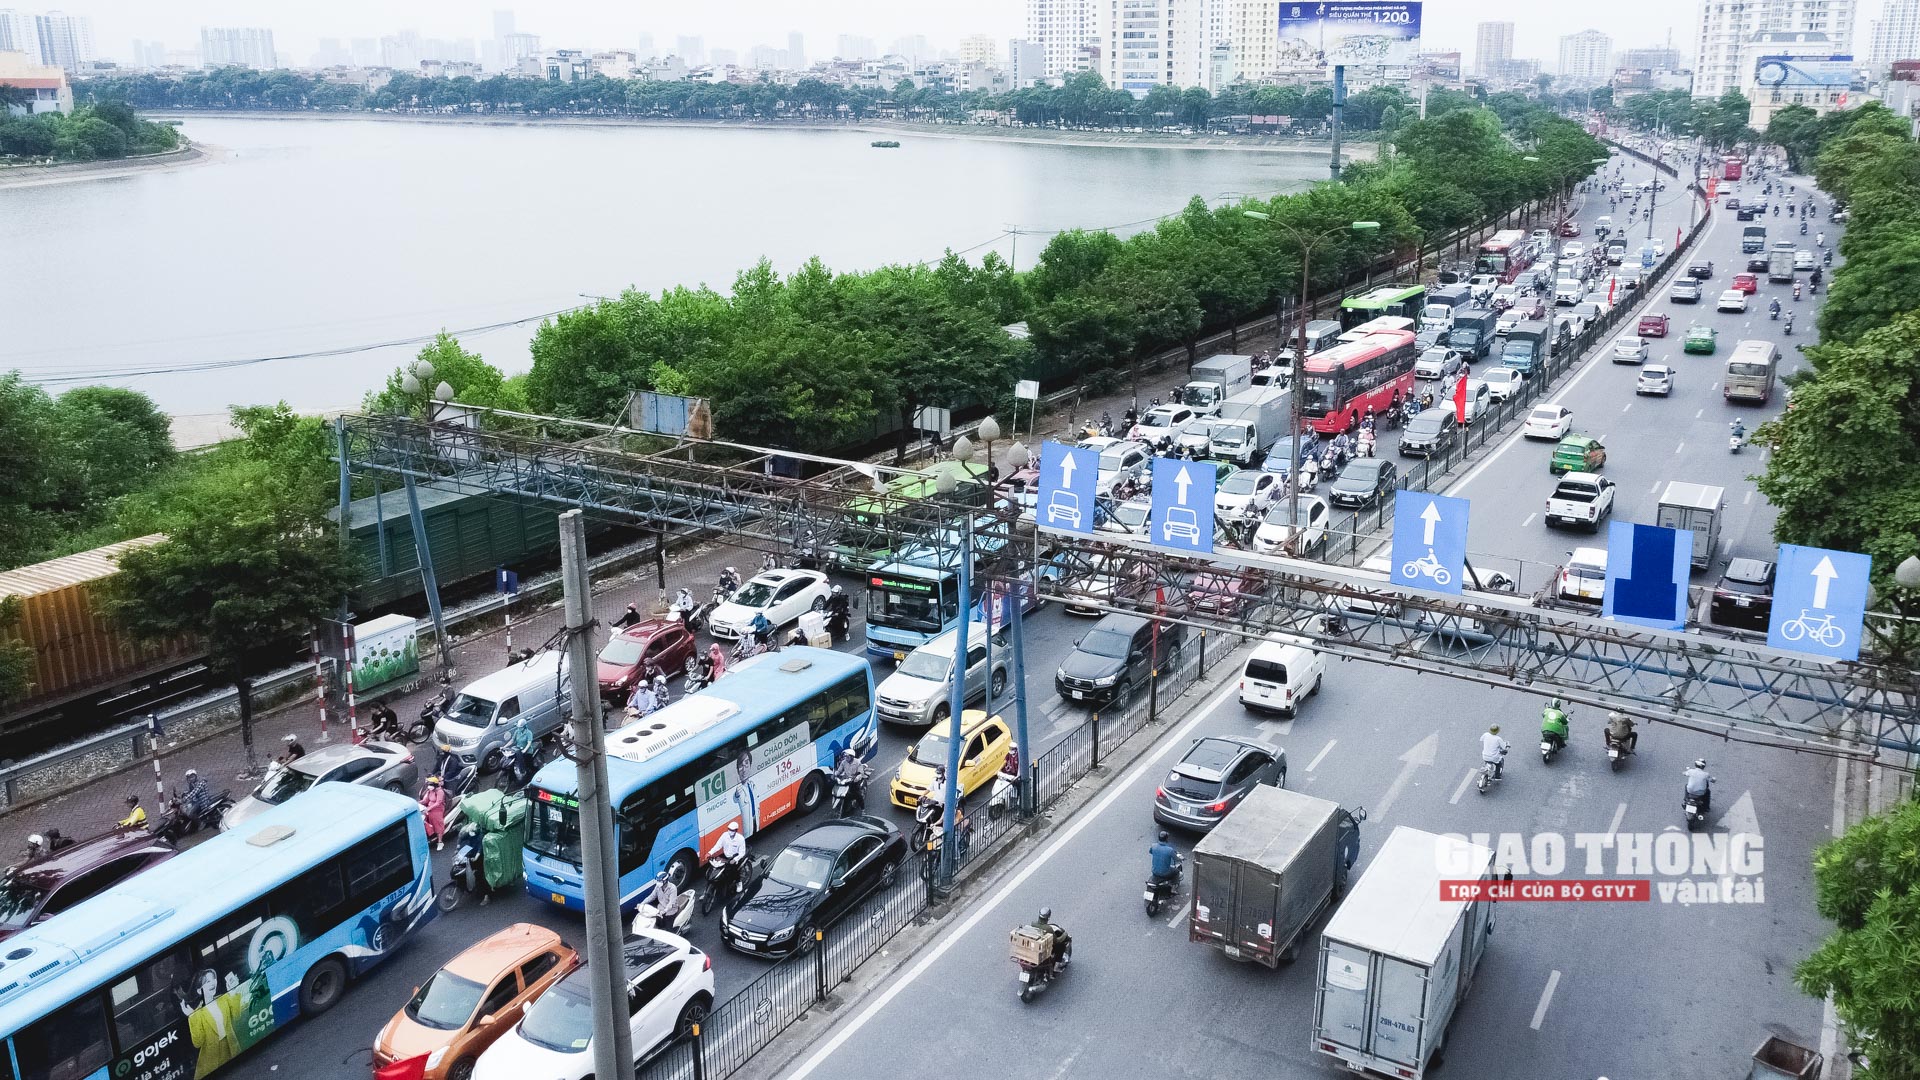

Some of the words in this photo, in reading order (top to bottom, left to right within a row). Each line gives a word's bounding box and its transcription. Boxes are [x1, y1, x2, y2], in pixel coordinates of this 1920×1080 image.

[1374, 11, 1410, 23] 1.200
[775, 758, 792, 776] 136
[701, 770, 727, 801] TCI
[133, 1029, 179, 1068] gojek
